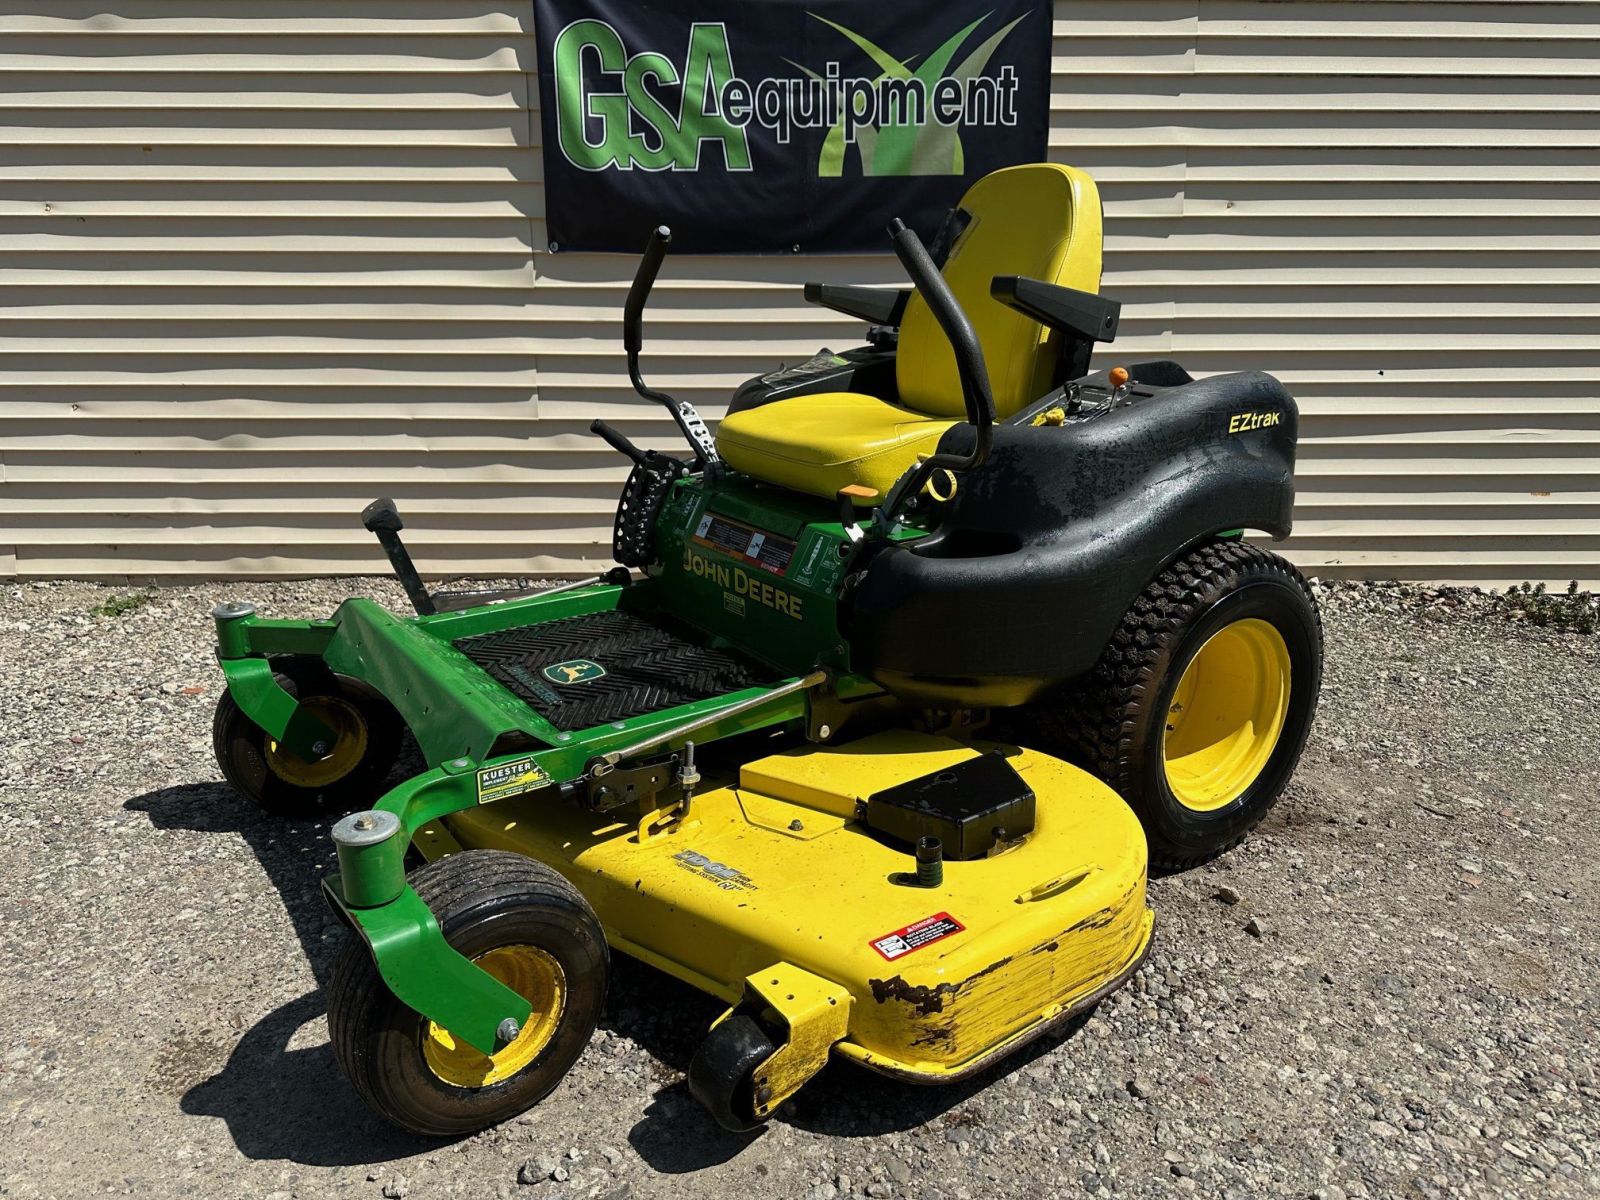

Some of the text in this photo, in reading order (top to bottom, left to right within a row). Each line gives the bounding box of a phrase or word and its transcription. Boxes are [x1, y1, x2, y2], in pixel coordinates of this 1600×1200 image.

[720, 61, 1019, 144] equipment
[1228, 411, 1280, 433] EZtrak
[683, 548, 730, 589] JOHN
[734, 567, 803, 620] DEERE
[482, 763, 531, 781] KUESTER
[671, 849, 741, 880] EDGE
[910, 917, 937, 931] DANGER
